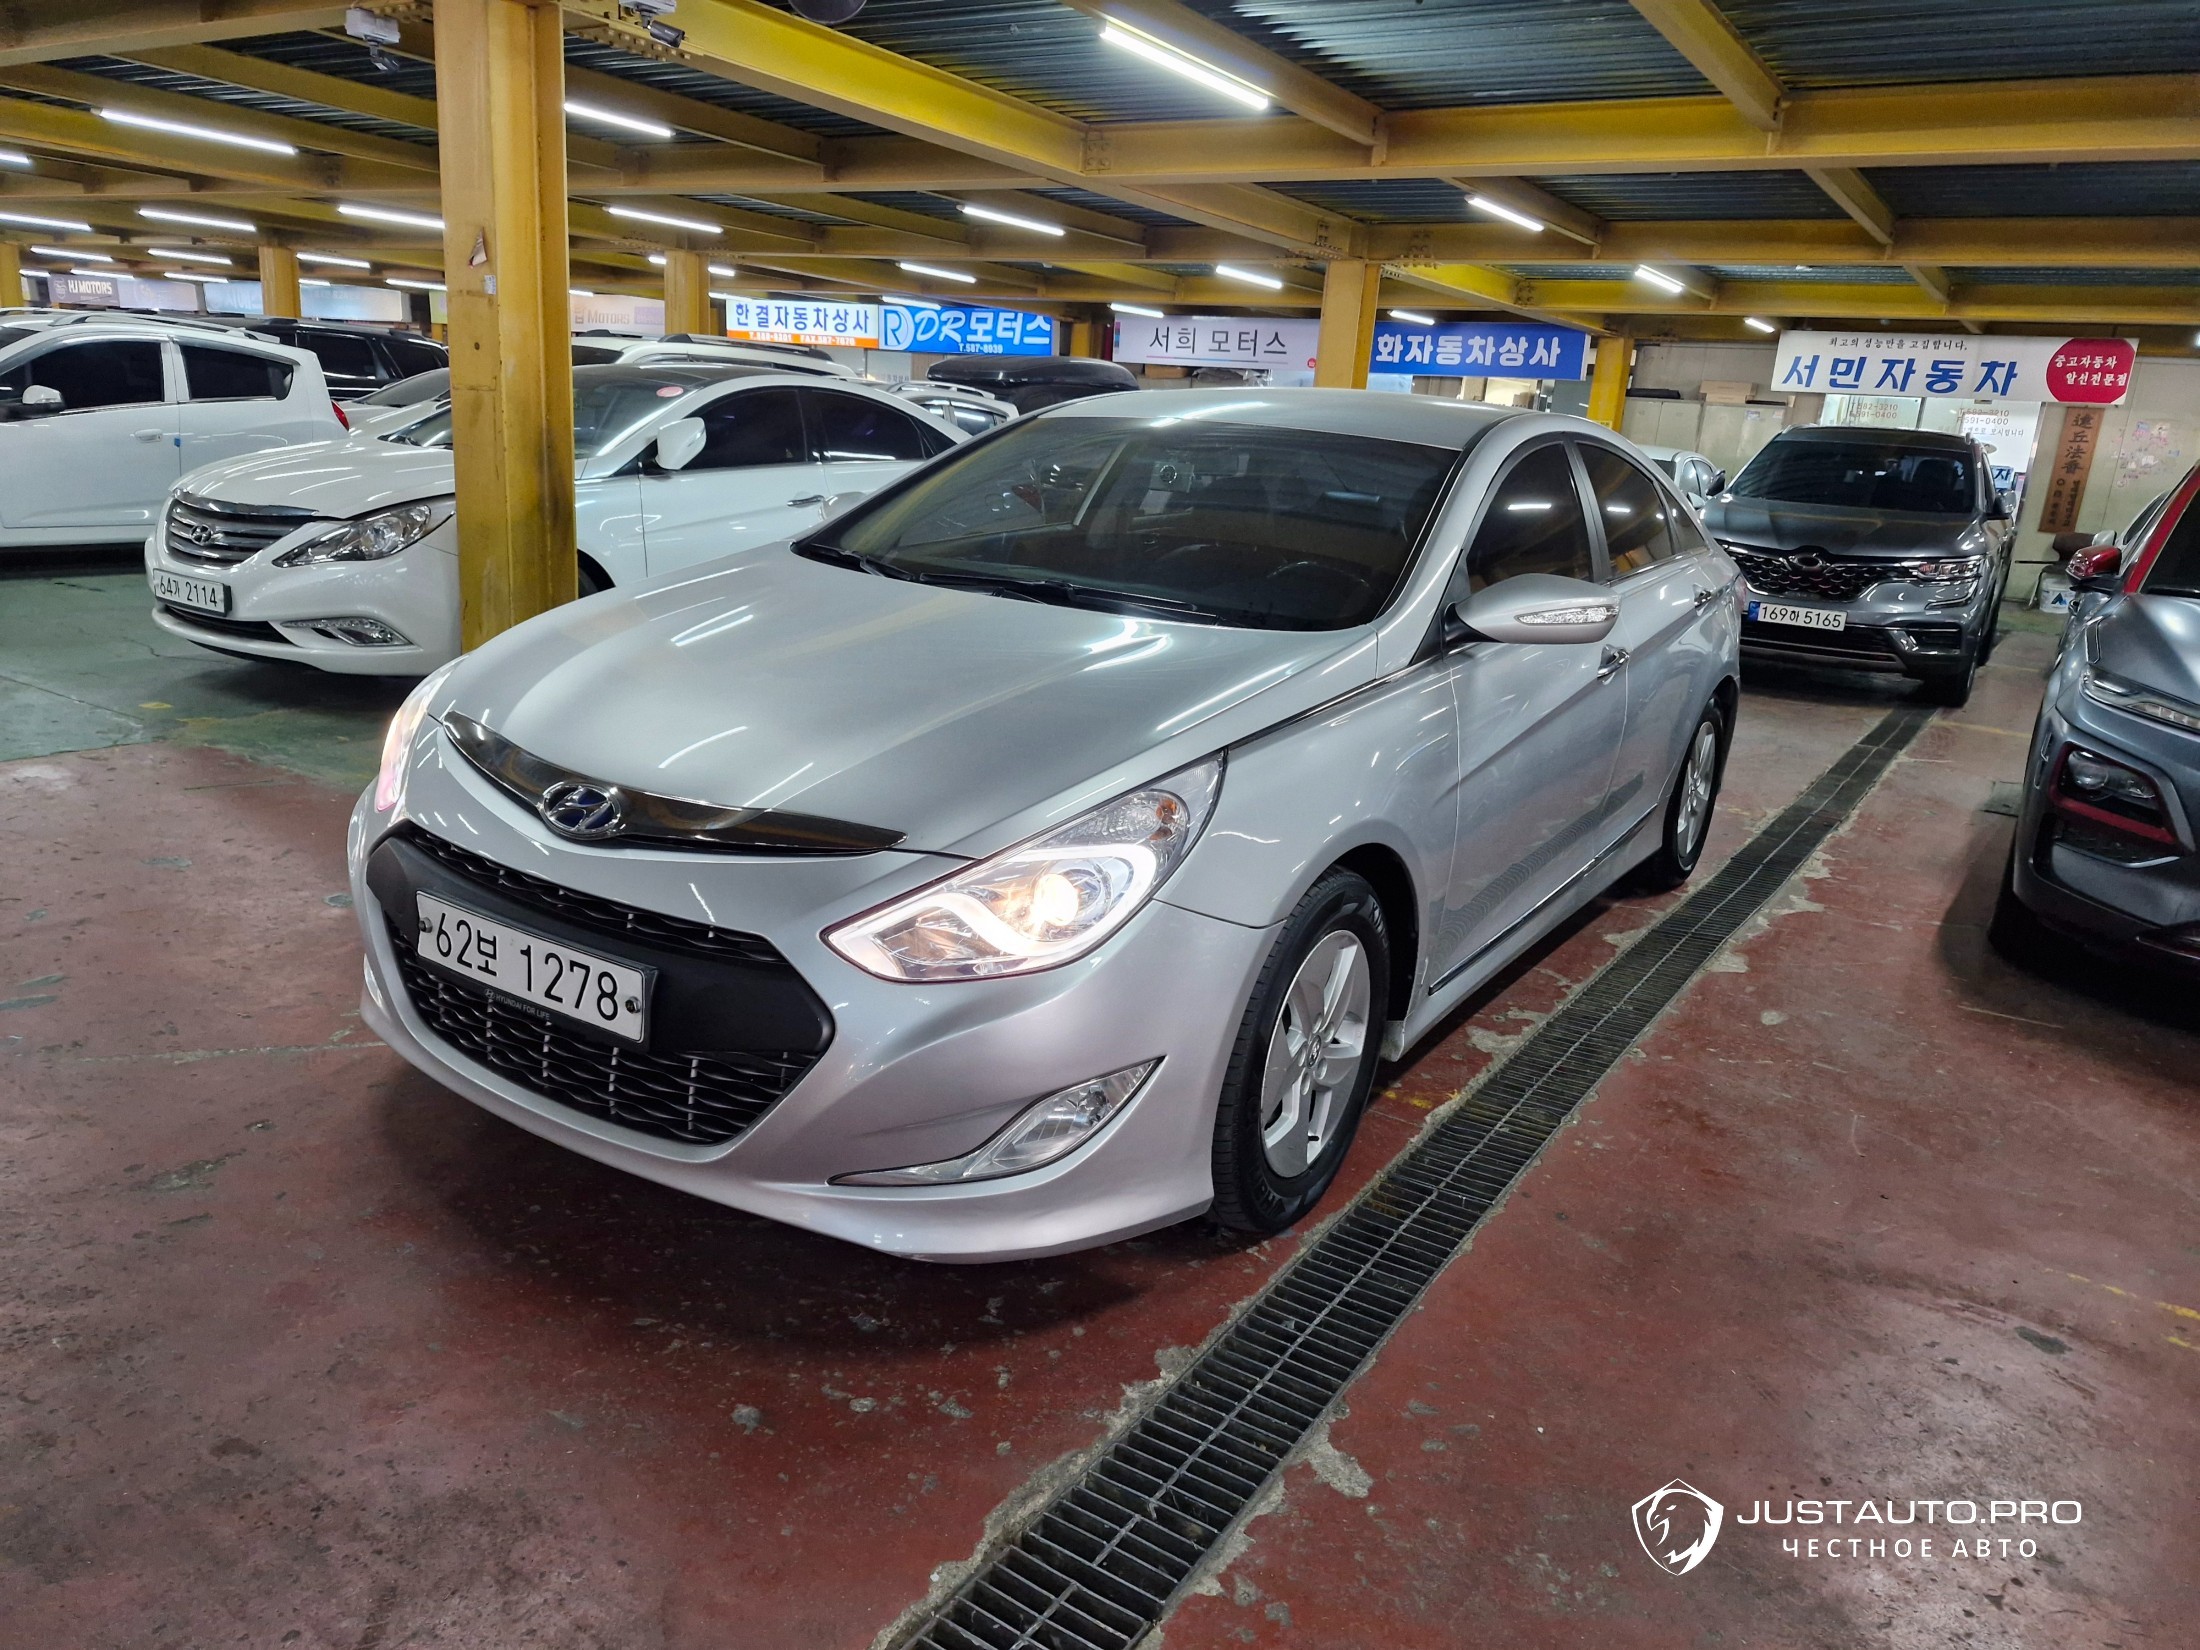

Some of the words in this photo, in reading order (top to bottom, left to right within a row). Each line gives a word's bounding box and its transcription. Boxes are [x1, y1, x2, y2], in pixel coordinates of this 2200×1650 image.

[78, 280, 113, 295] MOTORS
[735, 302, 869, 334] 한결자동차상사
[1149, 326, 1197, 354] 서희
[1208, 329, 1287, 357] 모터스
[1375, 333, 1561, 368] 화자동차상사
[1782, 354, 2018, 396] 서민자동차
[2055, 354, 2117, 369] 중고자동차
[2066, 371, 2128, 387] 알선전문점
[186, 582, 218, 607] 2114
[1762, 606, 1800, 622] 169하
[1803, 610, 1842, 628] 5165
[436, 912, 498, 977] 62보
[519, 944, 619, 1021] 1278
[495, 993, 522, 1010] HYUNDAI
[522, 1004, 536, 1015] FOR
[536, 1009, 551, 1020] LIFE
